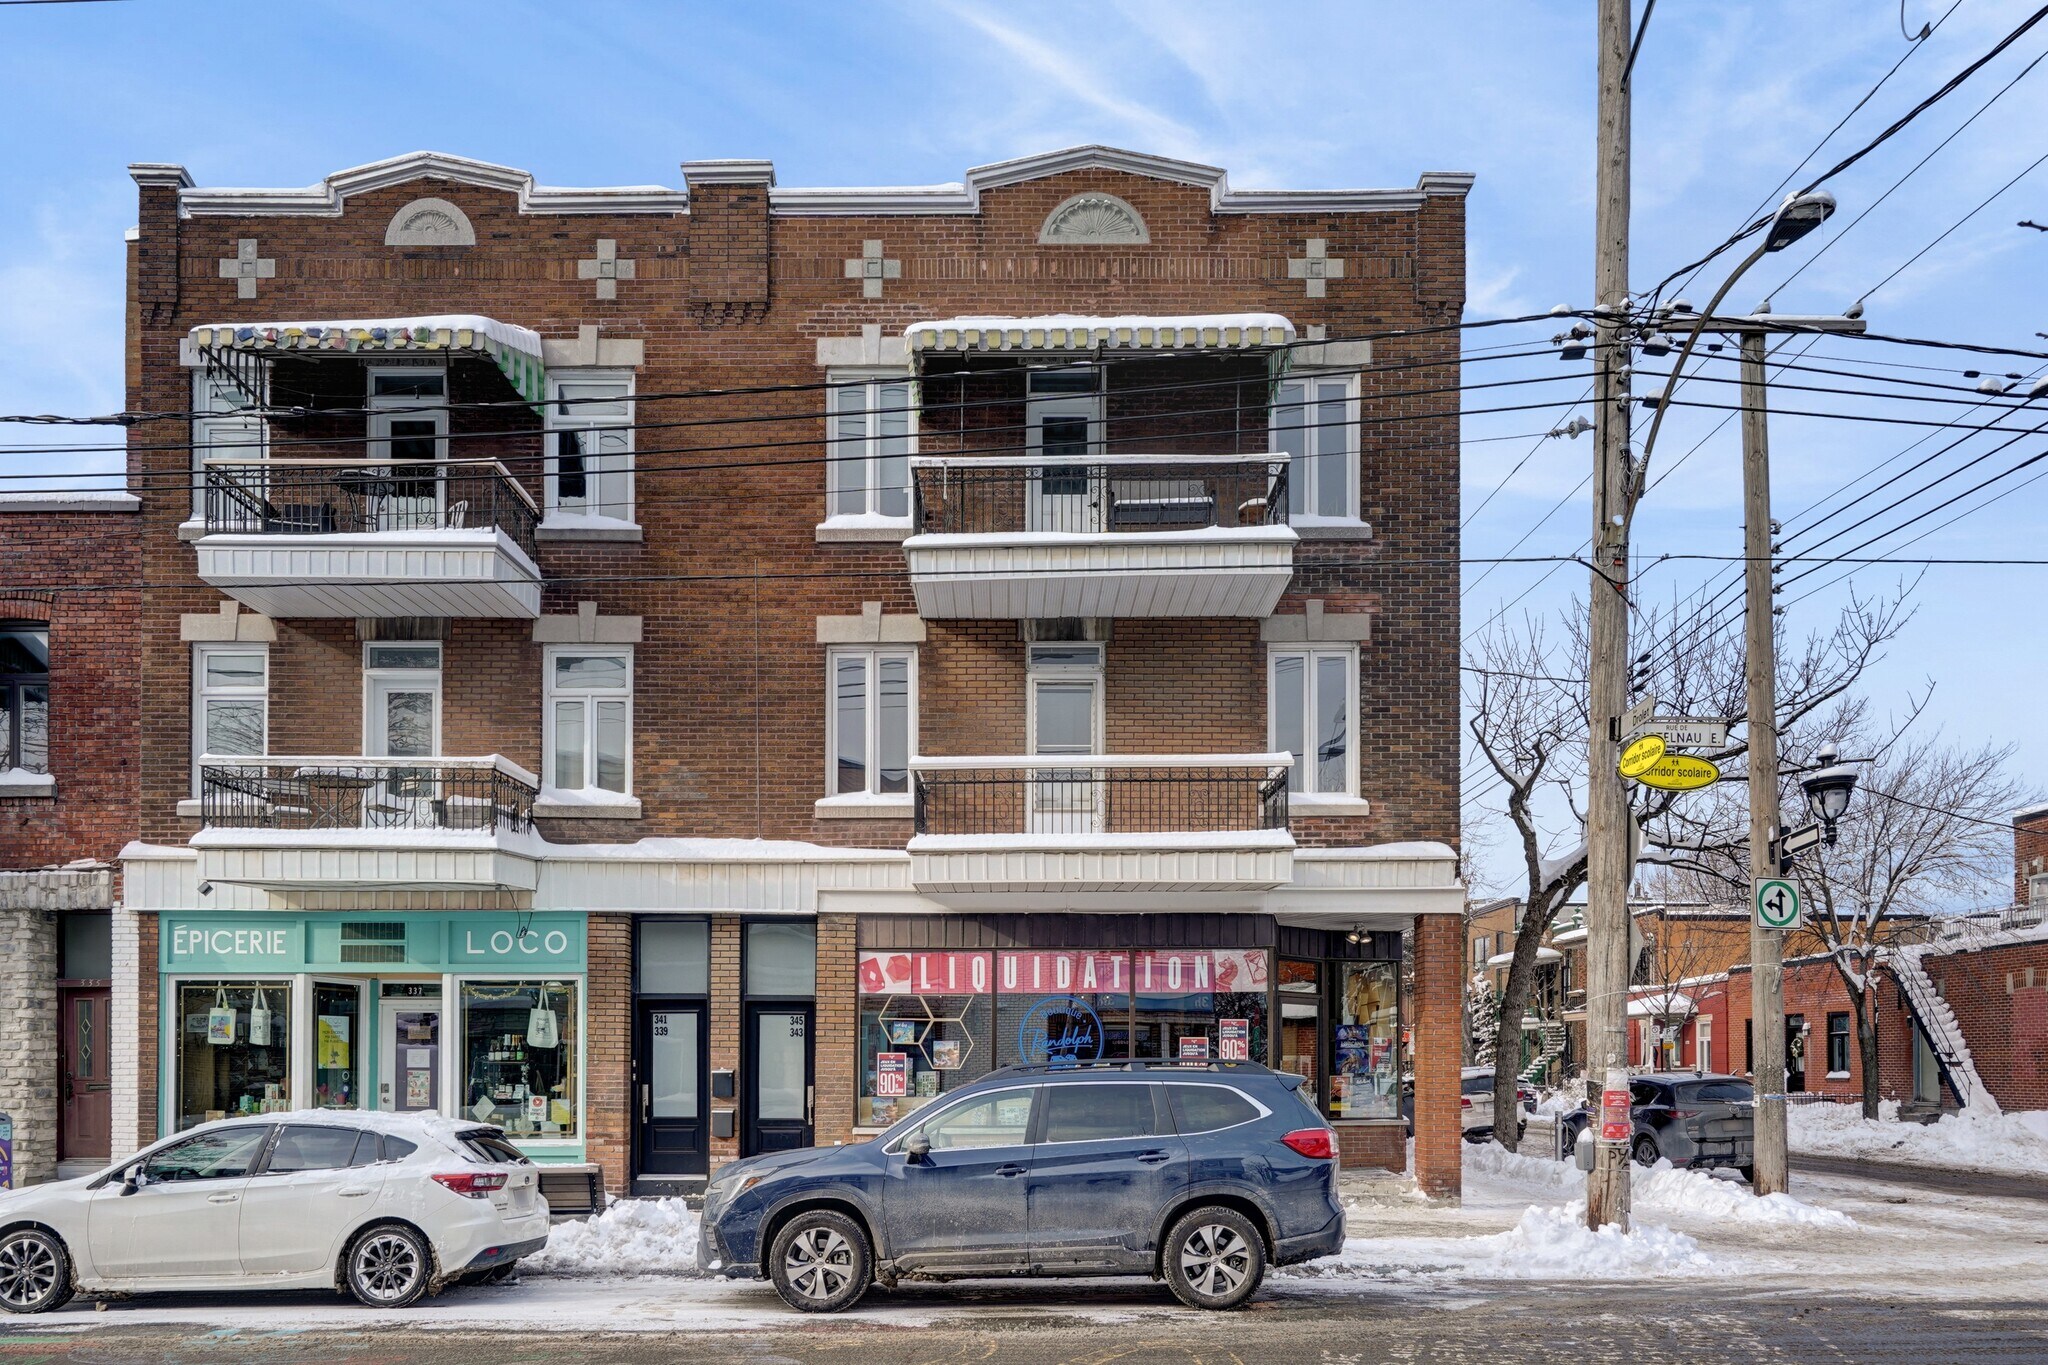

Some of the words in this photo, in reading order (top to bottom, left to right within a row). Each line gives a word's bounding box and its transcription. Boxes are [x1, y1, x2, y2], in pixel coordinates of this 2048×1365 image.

[1632, 708, 1650, 726] Drolet
[1712, 733, 1720, 744] E.
[1622, 752, 1641, 769] Corridor
[1641, 744, 1662, 760] scolaire
[1678, 767, 1712, 778] scolaire
[173, 924, 286, 954] ÉPICERIE
[466, 930, 568, 954] LOCO
[920, 954, 1210, 990] LIQUIDATION
[80, 978, 102, 987] 335
[408, 987, 423, 995] 337
[1040, 1005, 1082, 1020] Boutique
[654, 1015, 667, 1024] 341
[790, 1016, 804, 1026] 345
[654, 1026, 668, 1036] 339
[790, 1028, 804, 1037] 343
[1026, 1025, 1094, 1056] Randolph
[1222, 1039, 1245, 1060] 90%
[880, 1073, 903, 1094] 90%
